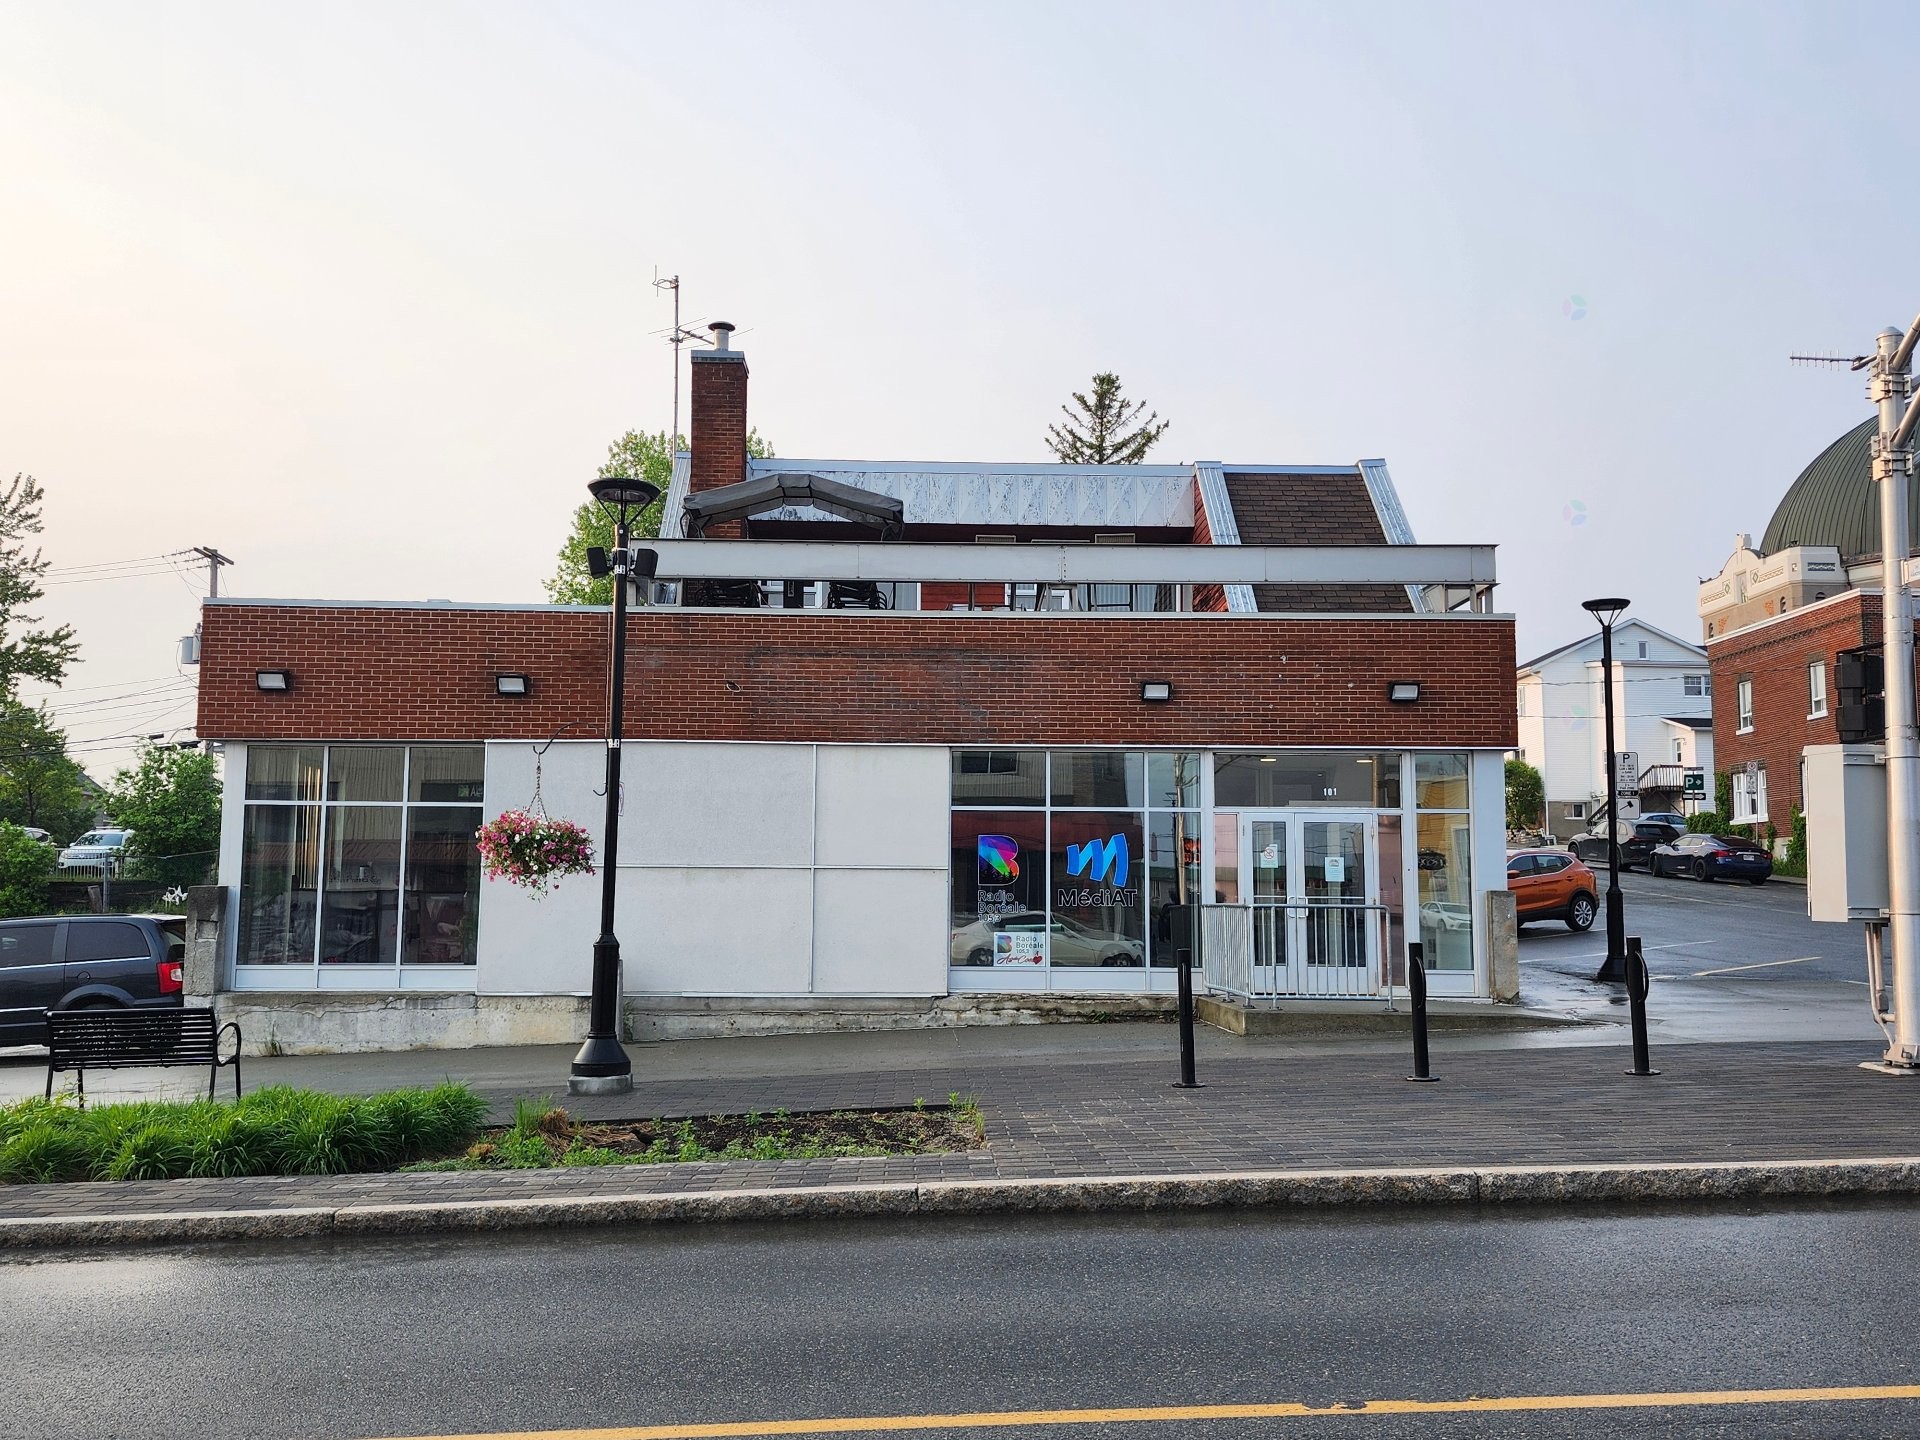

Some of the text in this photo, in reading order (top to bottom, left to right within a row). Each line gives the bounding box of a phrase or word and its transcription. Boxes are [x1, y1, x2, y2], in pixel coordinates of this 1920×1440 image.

[1623, 754, 1630, 763] P
[1685, 777, 1694, 788] P
[1323, 787, 1337, 796] 101
[977, 889, 1015, 902] Radio
[1057, 888, 1138, 907] MédiAT
[977, 901, 1027, 913] Boréale
